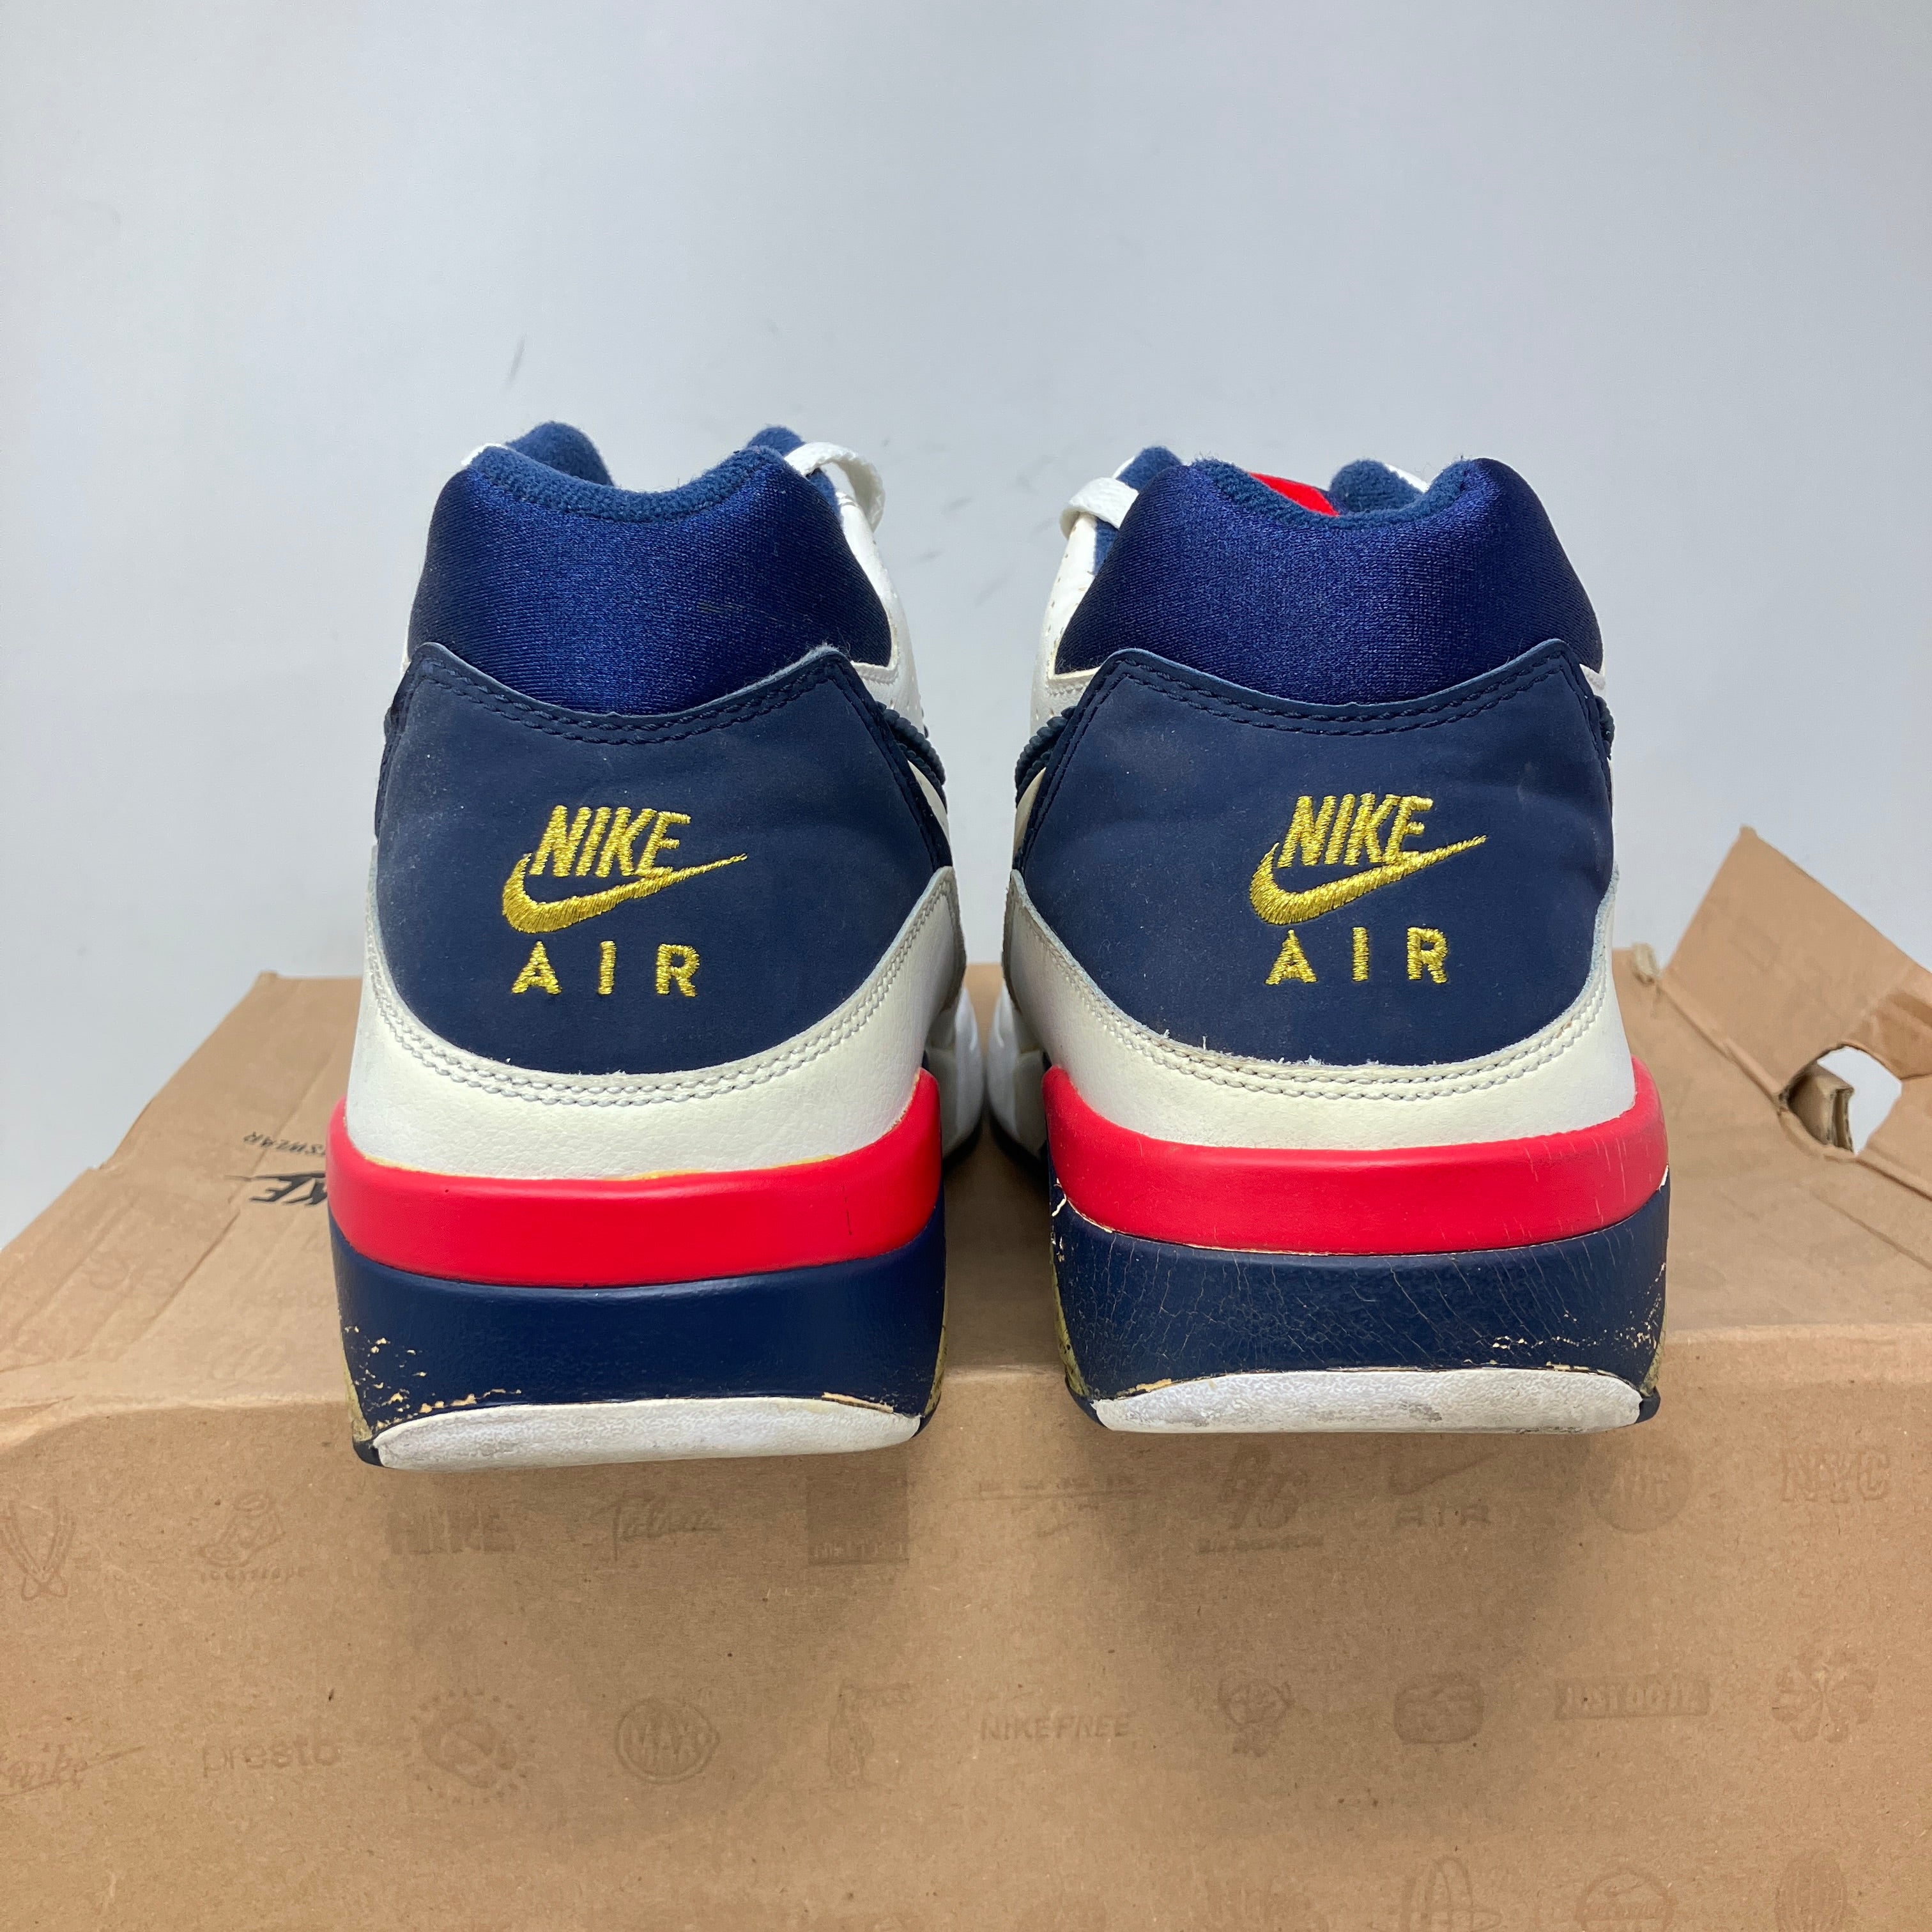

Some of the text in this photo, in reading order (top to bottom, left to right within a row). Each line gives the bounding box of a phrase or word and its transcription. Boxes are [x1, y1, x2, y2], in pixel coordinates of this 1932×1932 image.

[528, 805, 691, 878] NIKE
[1276, 792, 1434, 868] NIKE
[512, 940, 701, 997] AIR
[1264, 926, 1449, 985] AIR
[243, 1131, 326, 1158] SWEAR
[1781, 1446, 1890, 1503] NYC
[201, 1735, 342, 1779] presto
